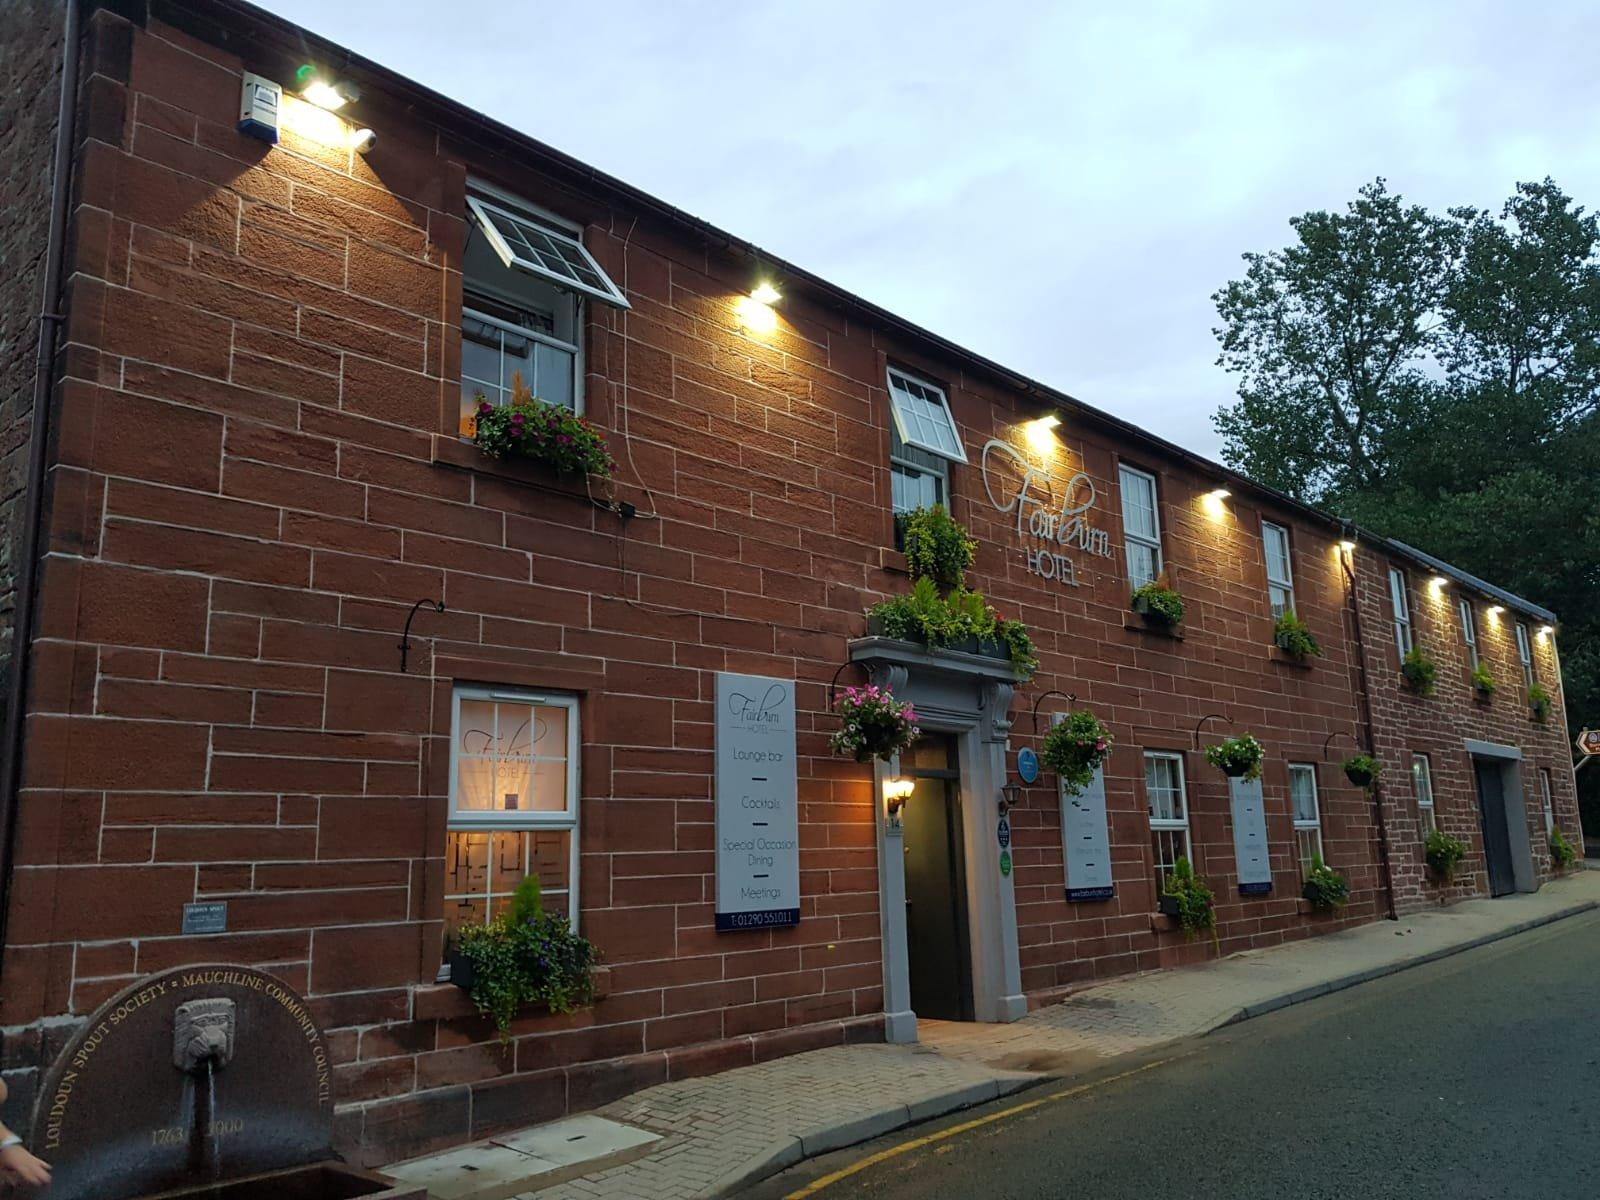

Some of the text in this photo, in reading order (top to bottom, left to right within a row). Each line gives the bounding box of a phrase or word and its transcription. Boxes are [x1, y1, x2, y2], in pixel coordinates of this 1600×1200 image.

[1025, 547, 1079, 587] HOTEL
[729, 683, 787, 724] Fairburn
[733, 747, 783, 763] Lounge bar
[741, 795, 781, 809] Cocktails
[723, 838, 755, 852] Special
[748, 853, 774, 867] Dining
[741, 887, 782, 900] Meetings
[738, 913, 763, 926] 01290
[764, 911, 792, 923] 551011
[45, 971, 329, 1150] LOUDOUN SPOUT SOCIETY MAUCHLINE COMMUNITY COUNCIL
[152, 1127, 184, 1145] 1763
